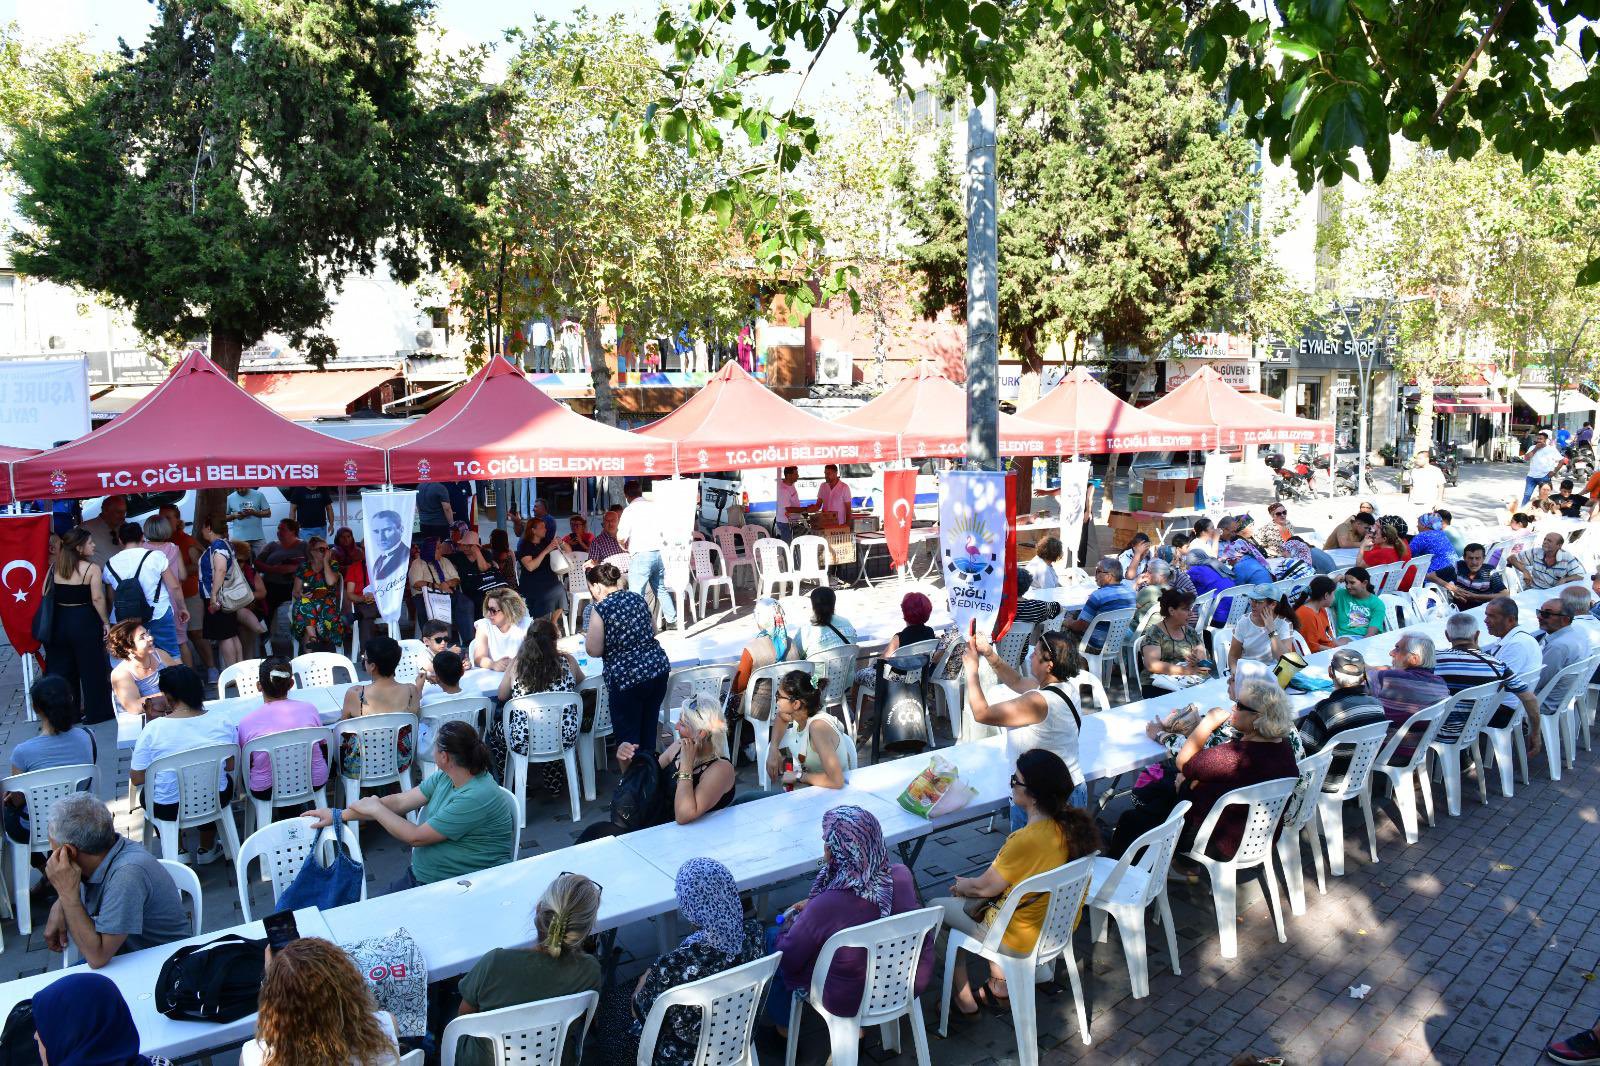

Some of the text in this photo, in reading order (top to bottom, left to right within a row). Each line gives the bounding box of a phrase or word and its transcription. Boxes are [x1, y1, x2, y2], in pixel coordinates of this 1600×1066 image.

[1299, 339, 1339, 354] EYMEN
[725, 451, 750, 464] T.C.
[453, 460, 485, 475] T.C.
[97, 463, 319, 488] T.C. ÇİĞLİ BELEDİYESİ
[953, 586, 987, 600] ÇİĞLİ
